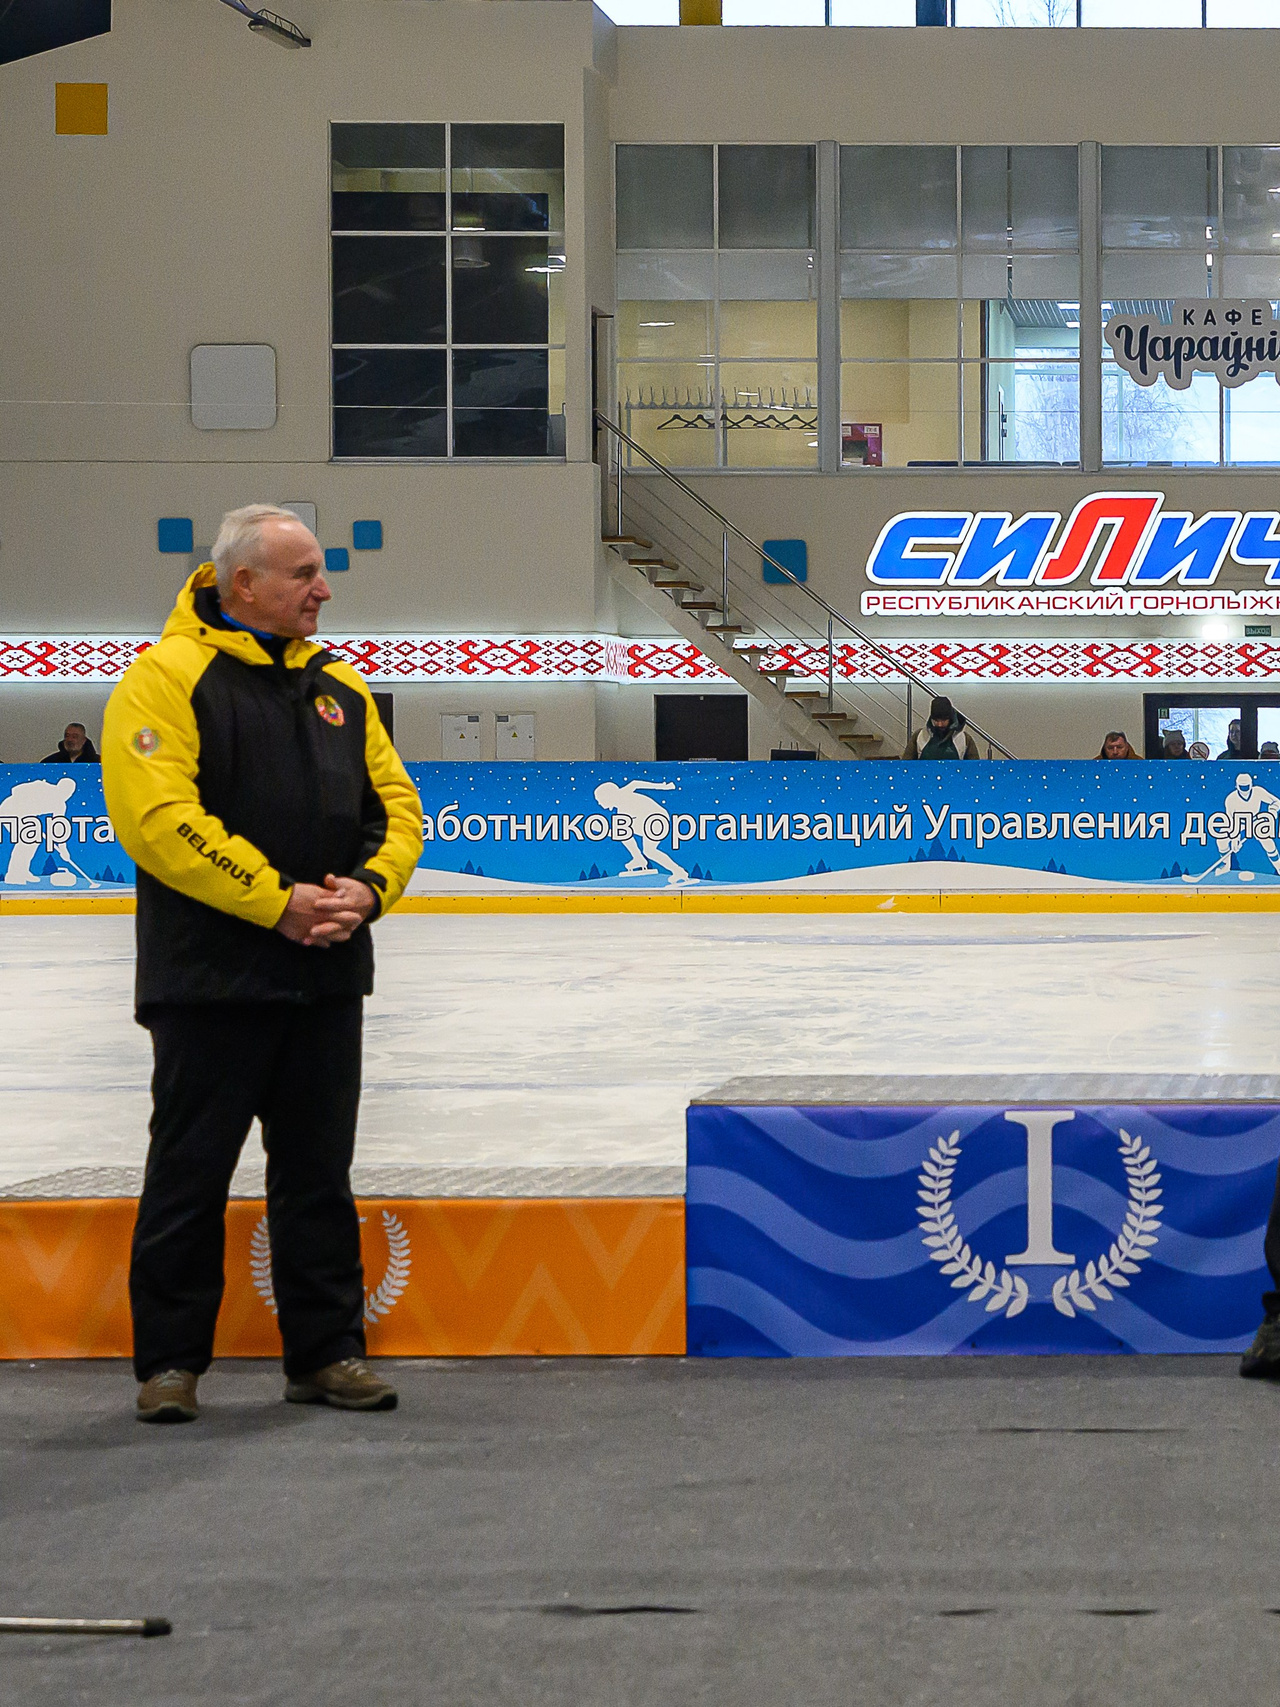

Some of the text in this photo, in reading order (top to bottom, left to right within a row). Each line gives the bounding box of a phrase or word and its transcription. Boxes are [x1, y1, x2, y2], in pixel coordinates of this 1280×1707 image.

[1183, 308, 1263, 326] КАФЕ
[866, 592, 1123, 610] РЕСПУБЛИКАНСКИЙ
[0, 815, 116, 853] парта
[422, 803, 634, 841] аботников
[643, 804, 913, 850] организаций
[922, 803, 1171, 849] Управления
[176, 822, 256, 887] BELARUS
